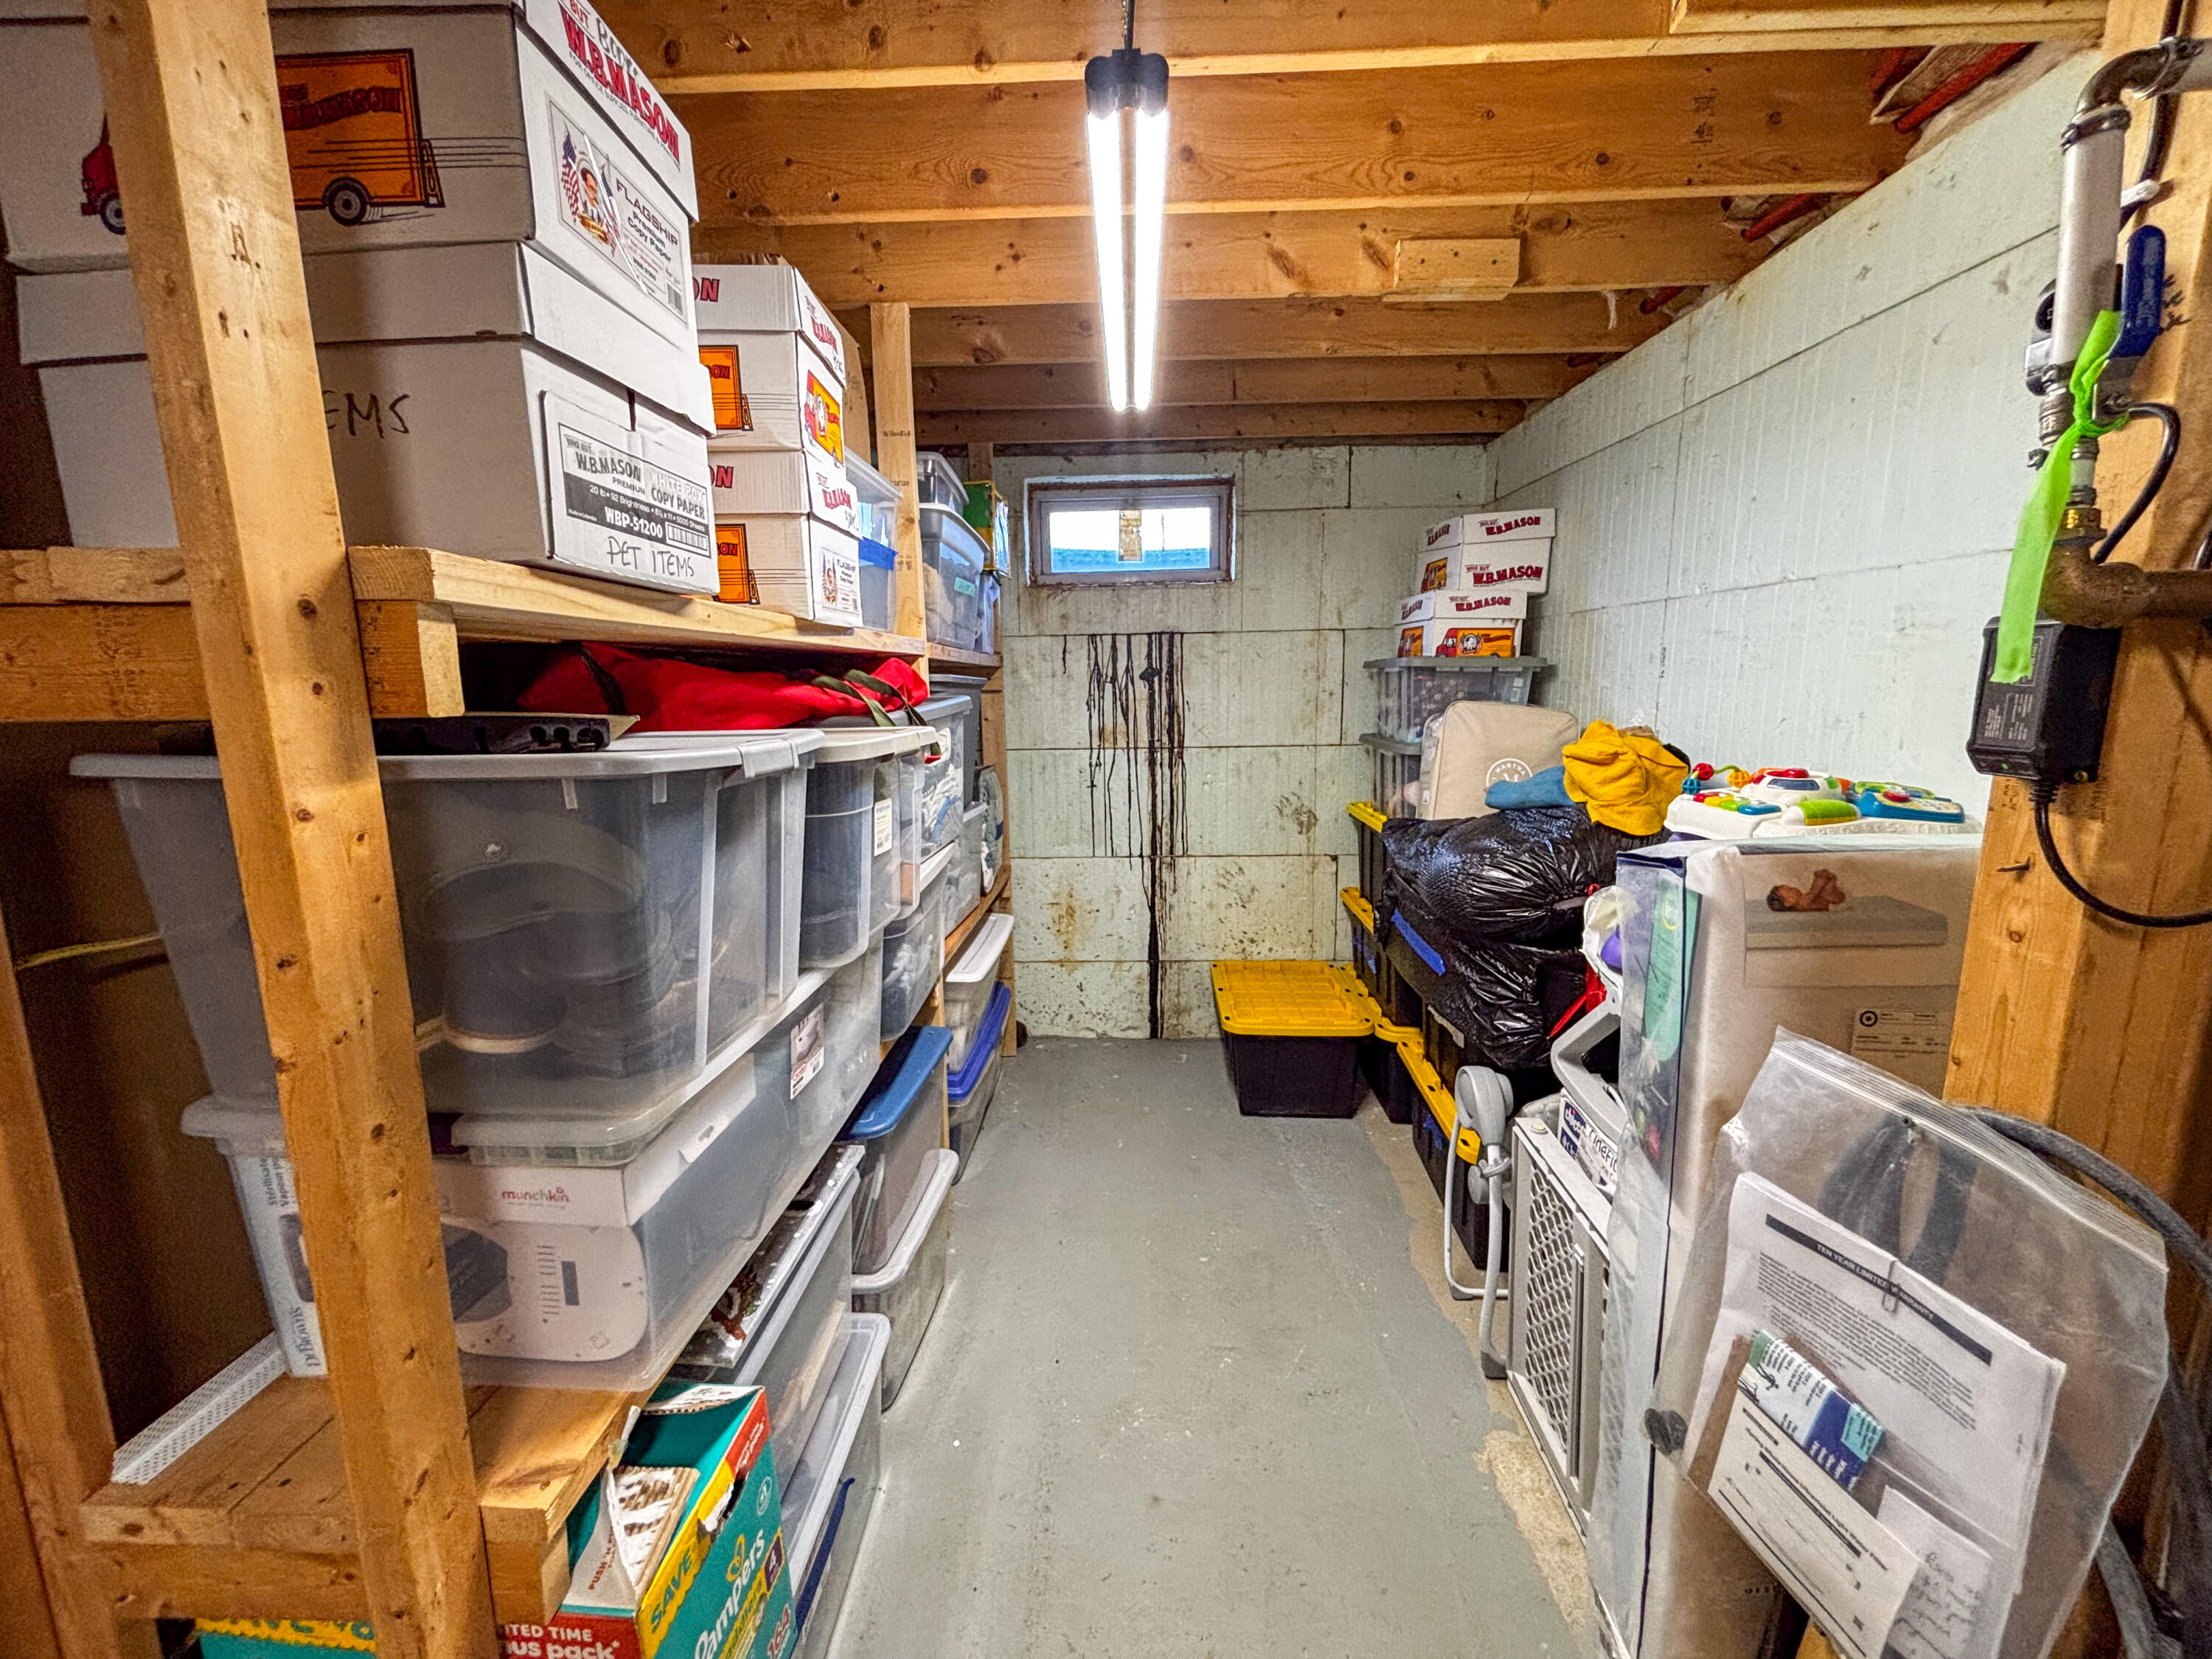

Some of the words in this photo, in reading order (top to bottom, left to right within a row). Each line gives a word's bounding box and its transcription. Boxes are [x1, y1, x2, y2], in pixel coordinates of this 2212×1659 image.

[560, 5, 681, 164] W.B.MASON
[616, 177, 678, 246] FLAGSHIP
[627, 216, 649, 243] Copy
[650, 237, 672, 264] Paper
[633, 210, 666, 249] Premium
[575, 452, 641, 482] W.B.MASON
[650, 470, 684, 494] WHITE
[590, 485, 599, 495] 20
[611, 493, 619, 503] 92
[619, 495, 650, 513] Brightness
[612, 476, 646, 495] PREMIUM
[651, 487, 675, 509] COPY
[677, 495, 706, 521] PAPER
[604, 506, 664, 539] WBP-51200
[1485, 516, 1541, 536] W.B.MASON
[606, 535, 641, 571] PET
[650, 549, 695, 578] ITEMS
[1472, 565, 1544, 585] W.B.MASON
[1455, 597, 1512, 612] W.B.MASON
[501, 1186, 570, 1203] munchkin
[1817, 1244, 1832, 1259] TEN
[1832, 1252, 1856, 1273] YEAR
[1856, 1265, 1891, 1290] LIMITED
[588, 1561, 608, 1590] PUSH
[650, 1545, 693, 1634] SAVE
[695, 1529, 765, 1659] Pampers
[504, 1623, 544, 1639] ITED
[547, 1625, 594, 1643] TIME
